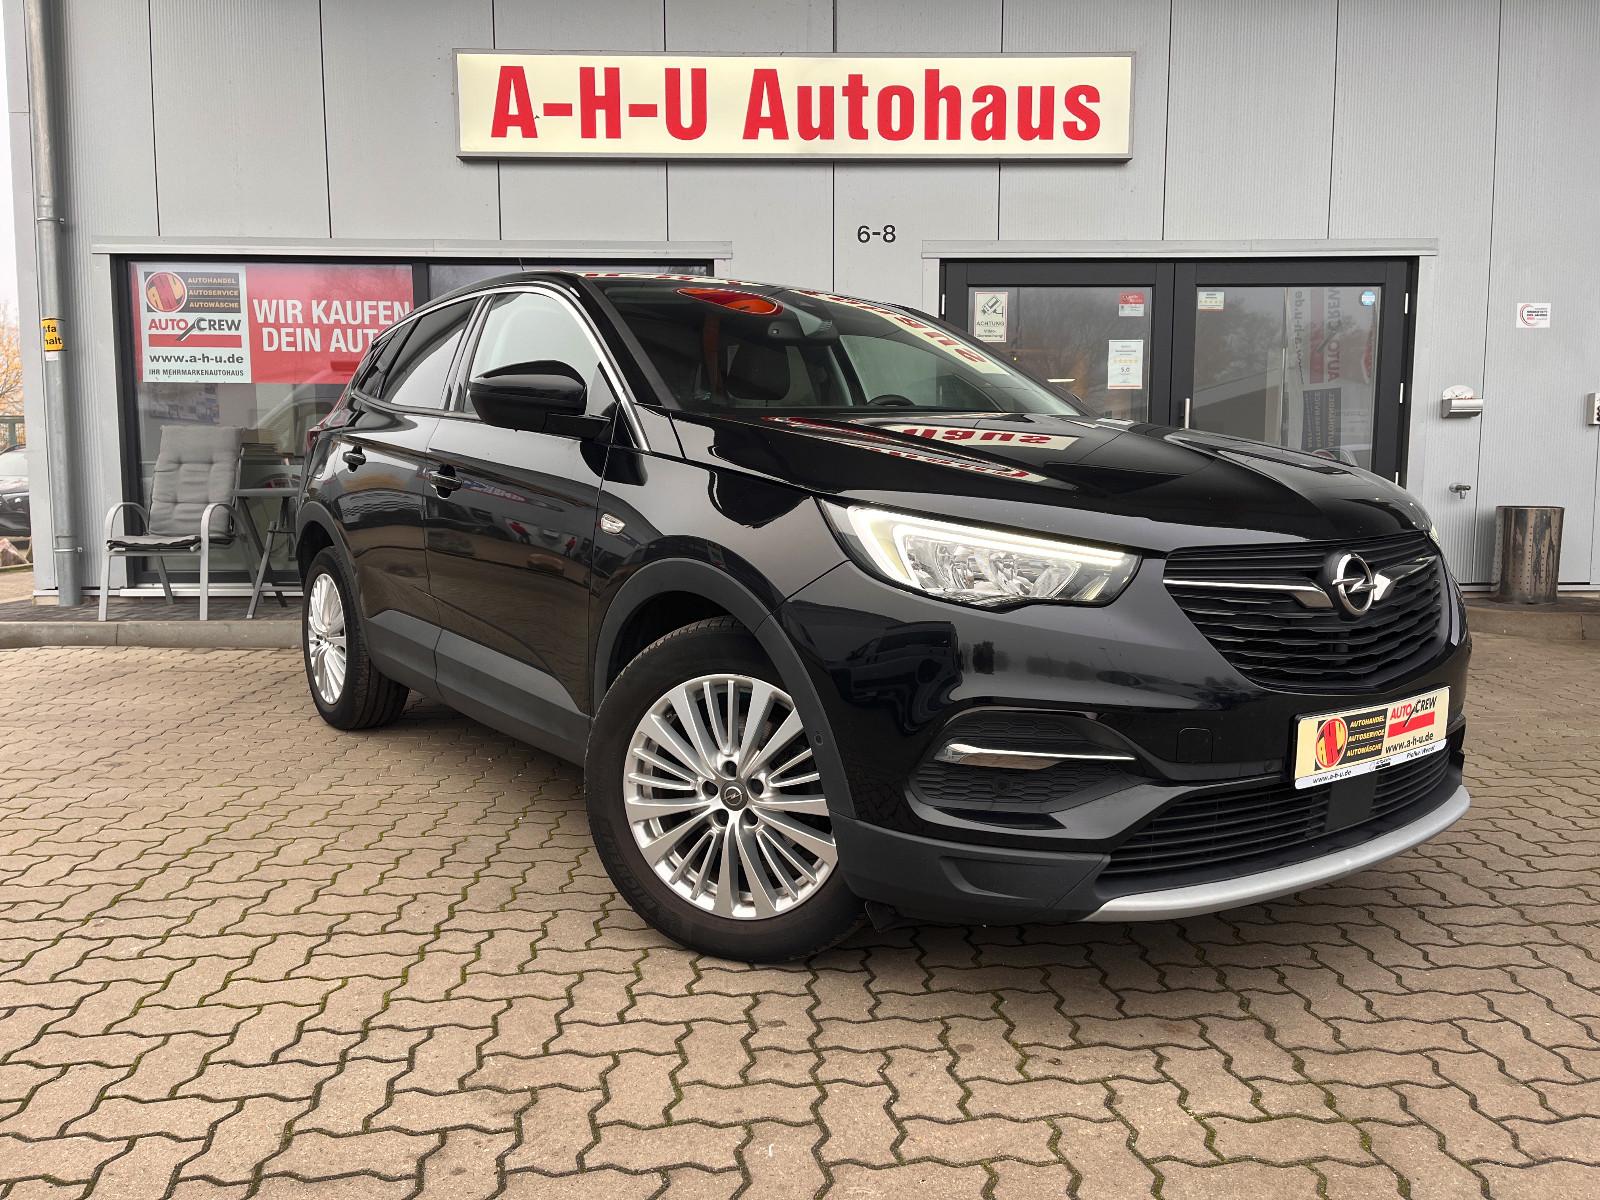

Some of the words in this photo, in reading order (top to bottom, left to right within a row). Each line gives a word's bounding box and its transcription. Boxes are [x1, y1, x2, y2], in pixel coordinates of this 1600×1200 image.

[490, 65, 708, 140] A-H-U
[742, 68, 1101, 142] Autohaus
[857, 225, 897, 244] 6-8
[189, 300, 239, 308] AUTOWÄSCHE
[252, 299, 304, 325] WIR
[311, 300, 410, 325] KAUFEN
[148, 318, 189, 331] AUTO
[196, 319, 242, 331] CREW
[262, 327, 321, 352] DEIN
[329, 328, 382, 353] AUT
[149, 353, 244, 364] www.a-h-u.de
[162, 369, 244, 377] MEHRMARKENAUTOHAUS
[1389, 703, 1412, 721] AUTO
[1414, 695, 1438, 714] CREW
[1349, 715, 1385, 728] AUTOHANDEL
[1347, 728, 1385, 742] AUTOSERVICE
[1385, 732, 1434, 755] www.a-h-u.de
